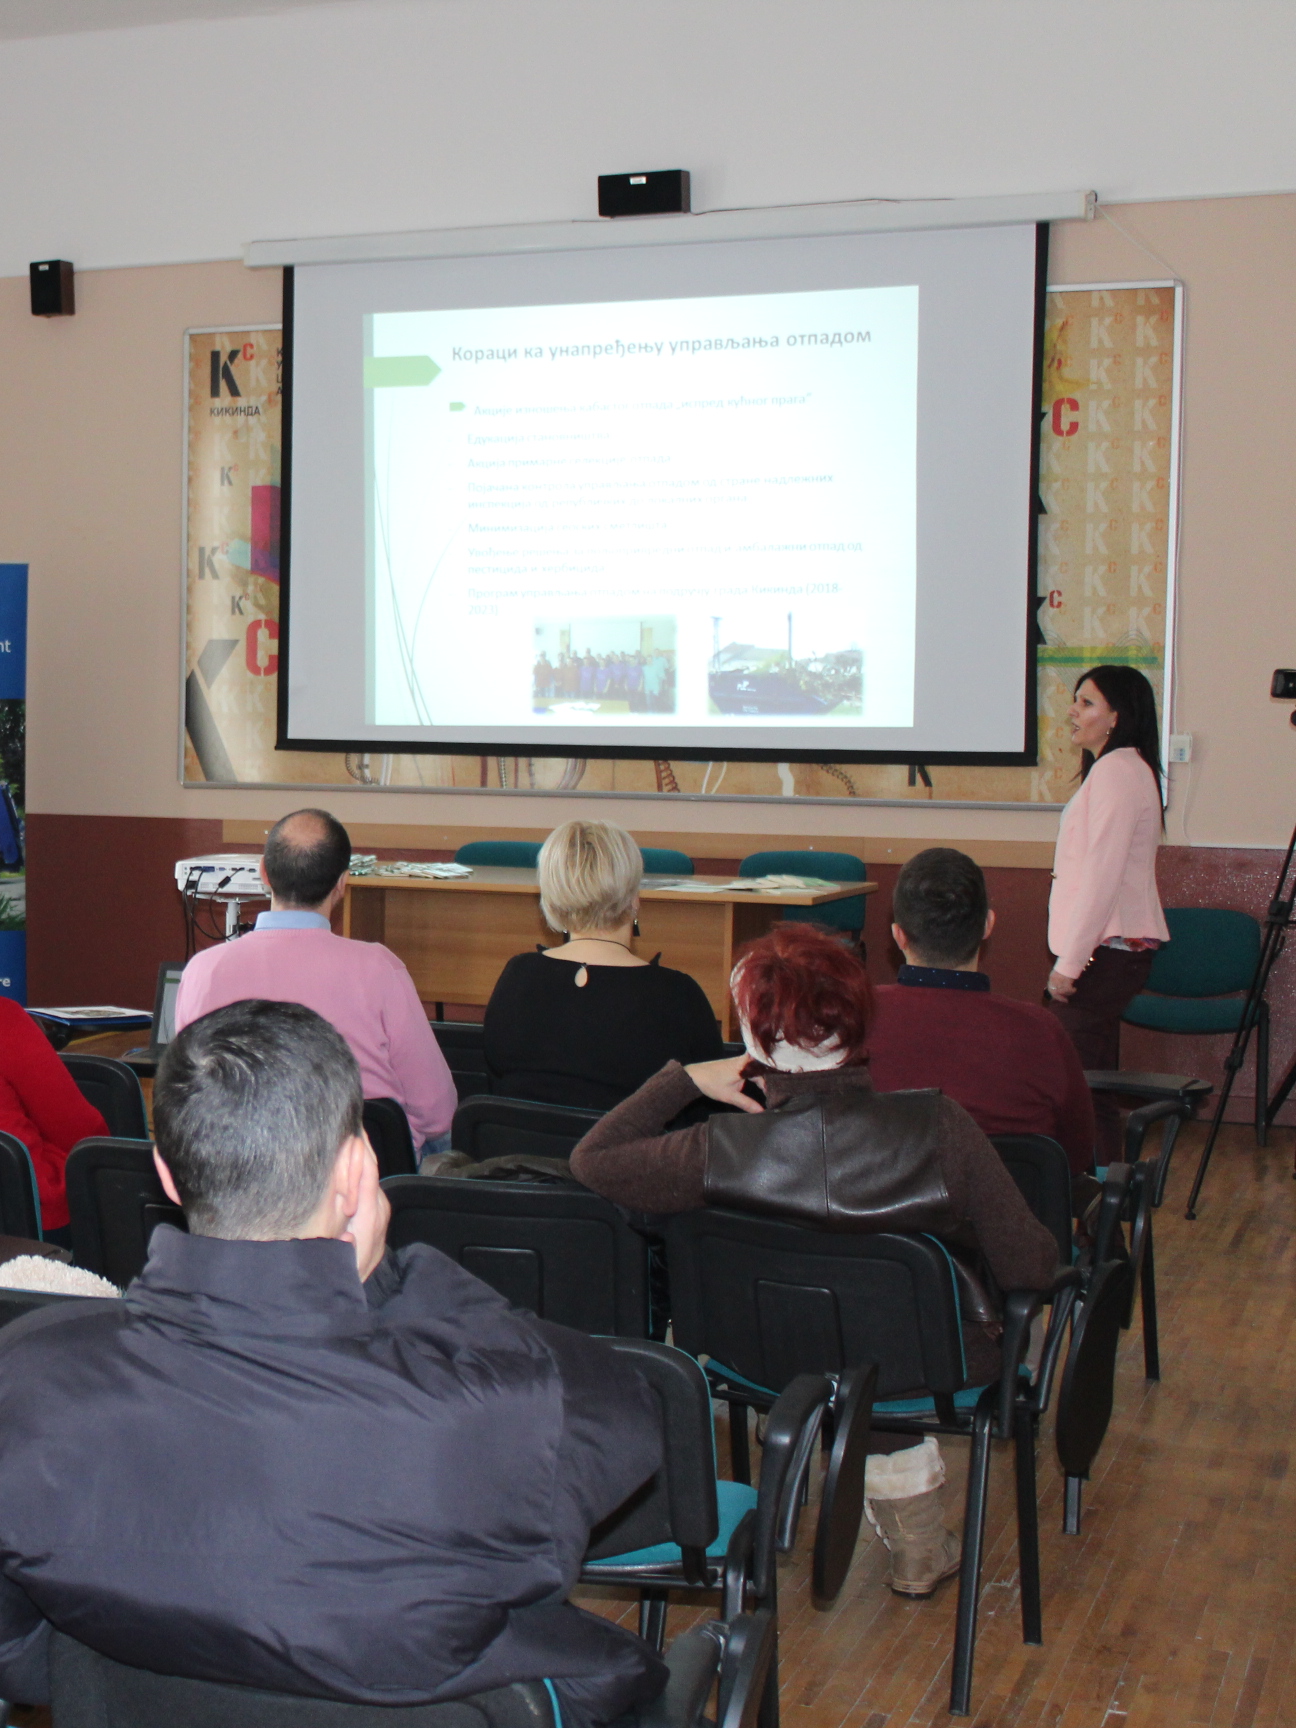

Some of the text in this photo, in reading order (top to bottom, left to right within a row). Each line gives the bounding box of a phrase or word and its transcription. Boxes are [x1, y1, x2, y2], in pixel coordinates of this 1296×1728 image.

[452, 329, 871, 363] Кораци ка унапређењу управљања отпадом
[728, 395, 767, 409] кућног
[210, 405, 260, 416] КИКИНДА
[468, 433, 524, 445] Едукација
[468, 483, 519, 495] Појачана
[764, 473, 834, 485] надлежних
[468, 523, 554, 535] Минимизација
[809, 542, 845, 553] отпад
[847, 541, 863, 552] од
[468, 588, 518, 600] Програм
[751, 584, 802, 596] Кикинда
[806, 582, 843, 596] (2018-
[468, 604, 498, 616] 2023)
